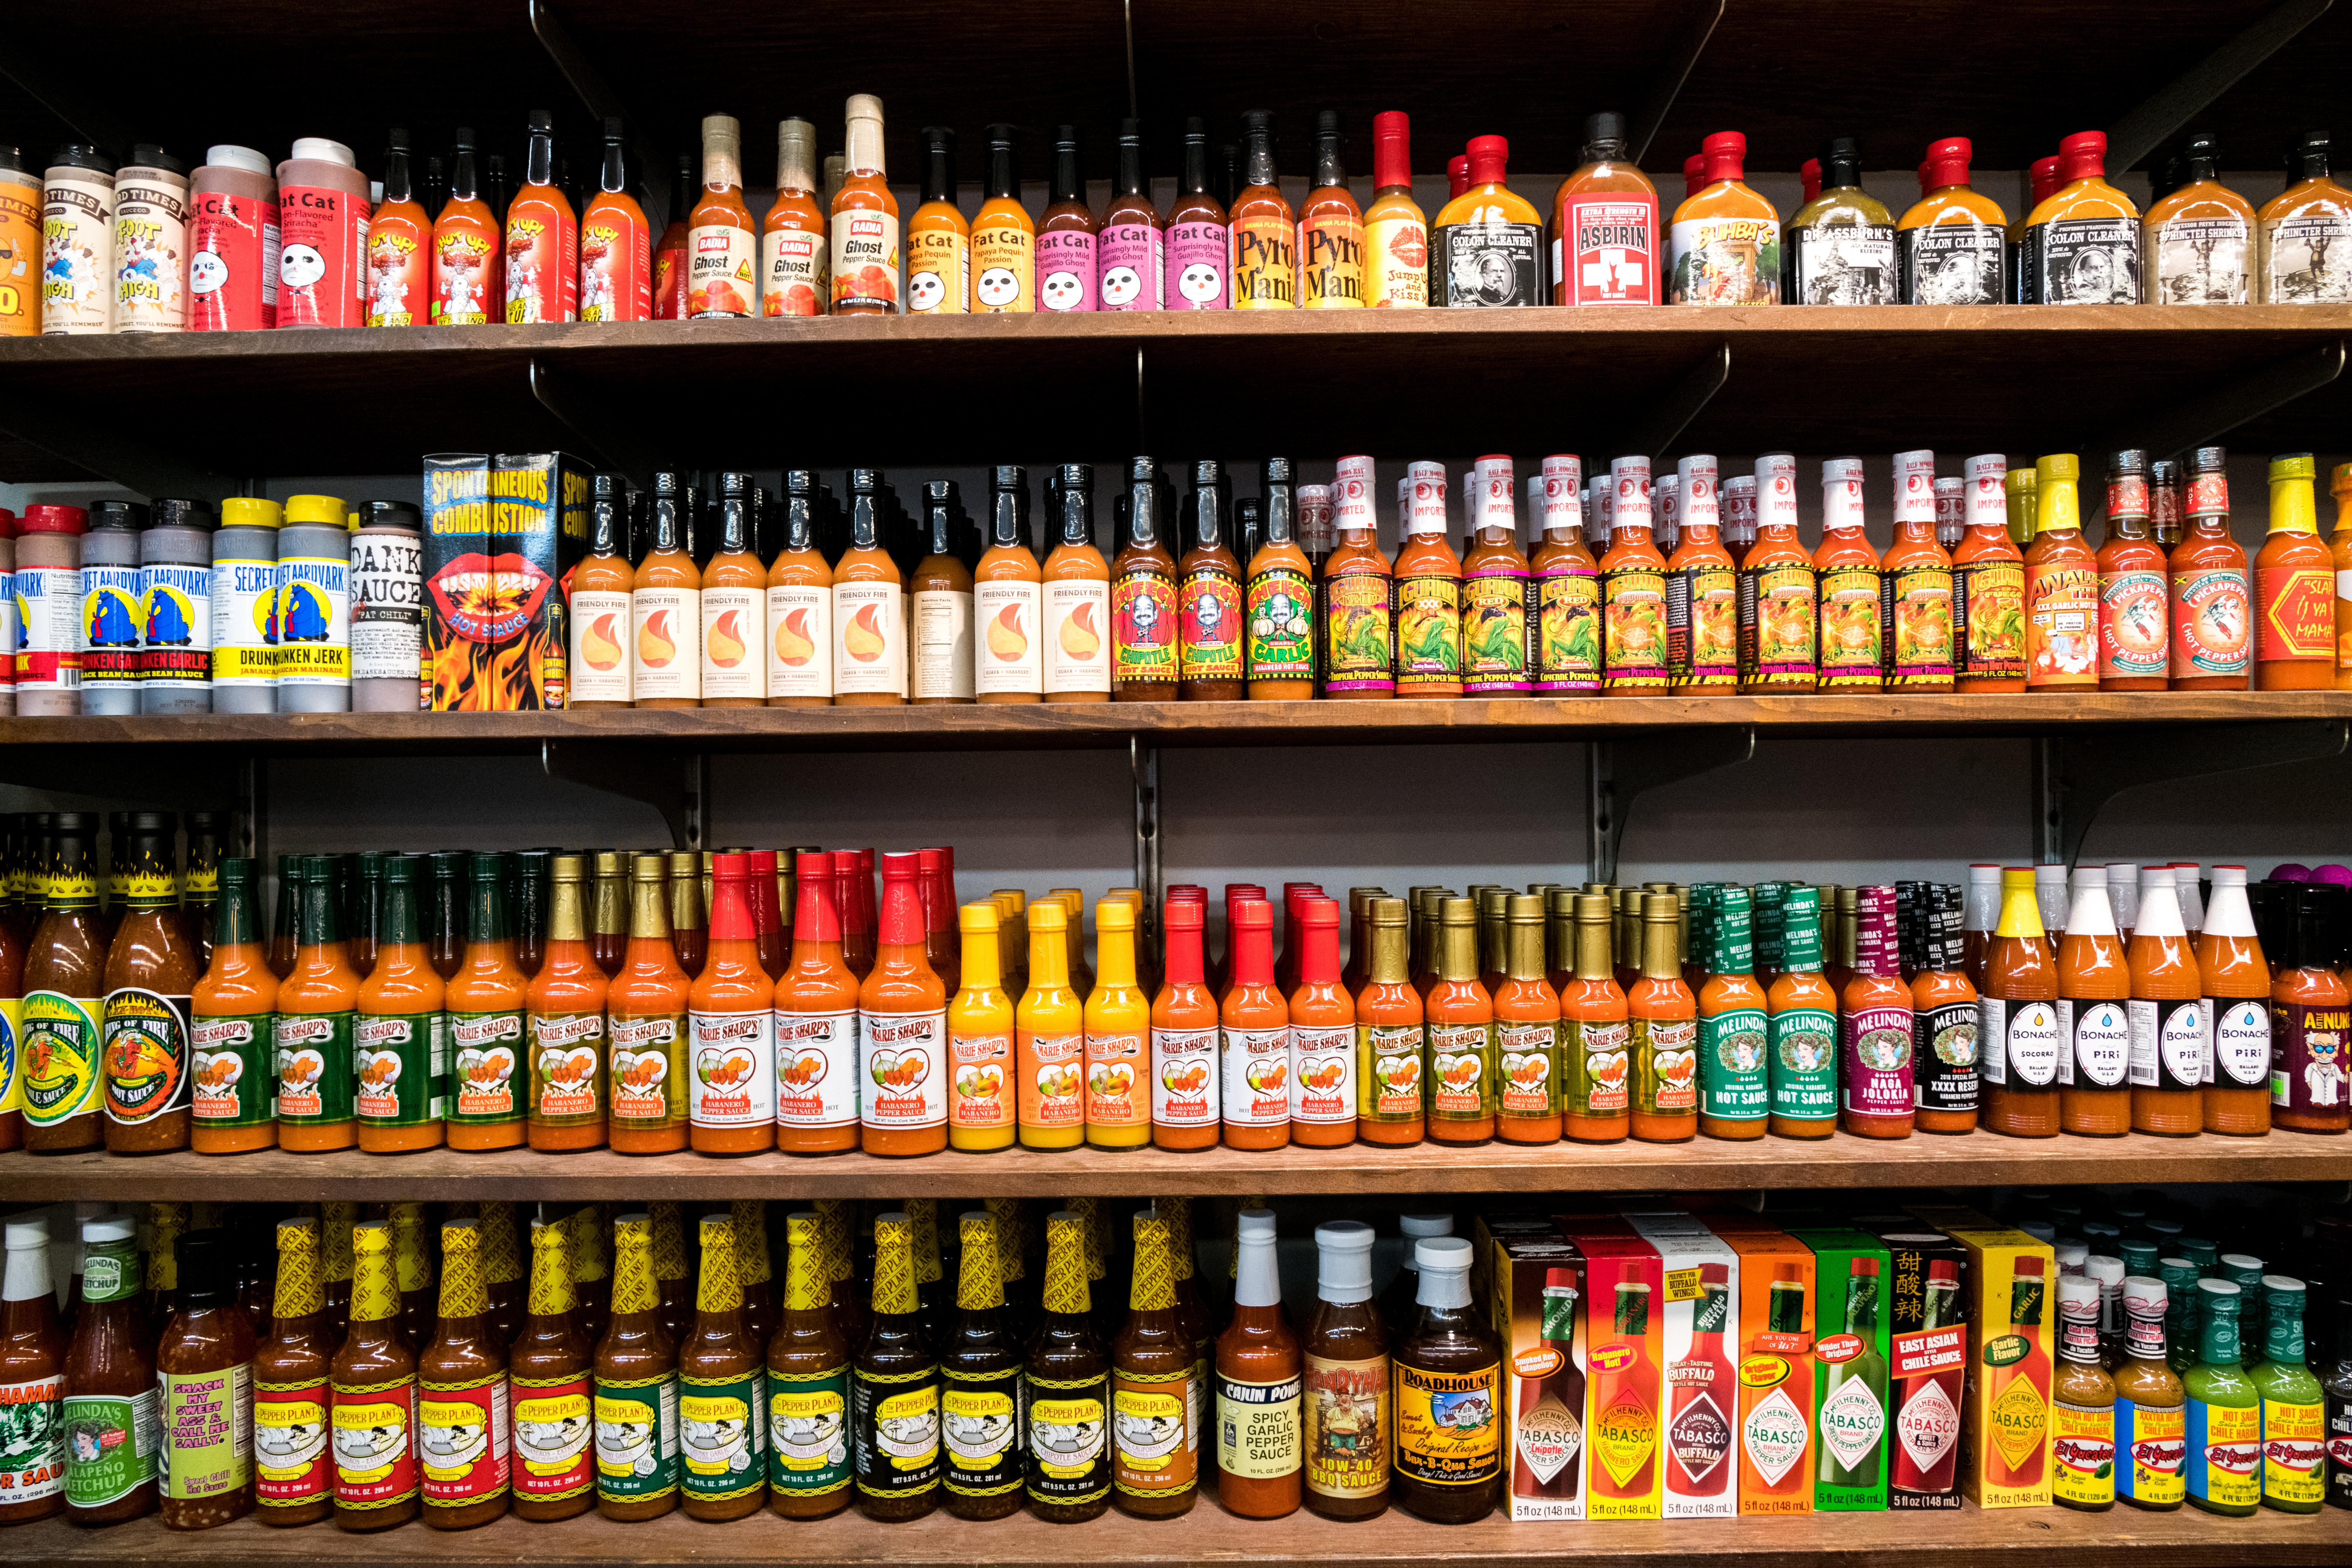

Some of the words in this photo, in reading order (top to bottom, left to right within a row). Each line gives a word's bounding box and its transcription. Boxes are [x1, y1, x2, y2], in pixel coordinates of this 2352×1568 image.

[134, 189, 179, 211] TIMES
[301, 193, 335, 210] Cat
[852, 221, 882, 234] BADIA
[1694, 221, 1774, 249] BUHBA'S
[2208, 228, 2246, 238] SHRINKE
[437, 231, 462, 256] SHUT
[469, 235, 492, 256] UP!
[974, 234, 994, 248] Fat
[999, 231, 1025, 246] Cat
[1453, 236, 1484, 247] COLON
[1487, 236, 1532, 247] CLEANER
[1580, 227, 1646, 251] ASBIRIN
[846, 240, 883, 254] Ghost
[974, 247, 996, 258] Papaya
[999, 249, 1024, 258] Pequin
[1173, 244, 1212, 253] Surprisingly
[1306, 229, 1362, 272] Pyro
[843, 255, 865, 264] Pepper
[866, 256, 885, 264] Sauce
[1177, 251, 1205, 261] Guajillo
[1206, 252, 1223, 261] Ghost
[119, 282, 159, 300] HIGH
[432, 469, 548, 506] SPONTANEOUS
[1546, 503, 1578, 514] IMPORTED
[432, 502, 546, 534] COMBUSTION
[352, 546, 422, 575] DANK
[235, 566, 273, 591] SECRET
[292, 564, 344, 592] AARDVARK
[352, 579, 422, 604] SAUCE
[1398, 580, 1458, 604] IGUANA
[2193, 583, 2247, 604] PICKAPEPPA
[1565, 596, 1587, 604] RED
[2314, 604, 2327, 617] YA
[449, 612, 479, 634] HOT
[2183, 629, 2199, 648] HOT
[2198, 646, 2240, 662] PEPPER
[169, 654, 208, 669] GARLIC
[315, 649, 343, 664] JERK
[1120, 649, 1170, 664] CHIPOTLE
[1786, 929, 1818, 940] MELINDA'S
[457, 1026, 480, 1041] MARIE
[482, 1018, 517, 1037] SHARP'S
[872, 1028, 896, 1042] MARIE
[898, 1020, 931, 1038] SHARP'S
[1779, 1016, 1833, 1037] MELINDA'S
[1857, 1013, 1911, 1035] MELINDA'S
[142, 1021, 169, 1045] FIRE
[2222, 1029, 2268, 1039] BONACHE
[1870, 1078, 1902, 1088] NAGA
[1777, 1090, 1797, 1104] HOT
[1802, 1091, 1833, 1103] SAUCE
[1862, 1089, 1908, 1100] JOLOKIA
[1894, 1252, 1923, 1323] 甜酸辣
[1899, 1338, 1924, 1354] EAST
[1927, 1333, 1958, 1349] ASIAN
[1992, 1338, 2019, 1351] Garlic
[1515, 1356, 1541, 1365] Smoked
[1592, 1348, 1630, 1361] Habanero
[1902, 1357, 1928, 1370] CHILE
[1931, 1353, 1962, 1366] SAUCE
[1993, 1348, 2020, 1361] Flavor
[1520, 1361, 1554, 1373] Jalapeños
[1604, 1358, 1621, 1368] Hot!
[1745, 1361, 1778, 1374] Original
[1405, 1371, 1492, 1391] ROADHOUSE
[1668, 1368, 1715, 1382] BUFFALO
[1750, 1372, 1775, 1382] Flavor
[174, 1379, 224, 1393] SMACK
[1226, 1384, 1266, 1402] CAJUN
[187, 1393, 209, 1404] MY
[176, 1402, 223, 1415] SWEET
[340, 1410, 367, 1423] PEPPER
[369, 1408, 396, 1422] PLANT
[2280, 1406, 2295, 1418] HOT
[2299, 1408, 2319, 1419] SAUCE
[178, 1417, 206, 1426] ASS
[210, 1414, 221, 1423] &
[1253, 1410, 1289, 1424] SPICY
[1825, 1412, 1880, 1429] TABASCO
[171, 1425, 206, 1438] CALL
[209, 1421, 229, 1432] ME
[1247, 1421, 1293, 1435] GARLIC
[1247, 1432, 1293, 1447] PEPPER
[1519, 1429, 1579, 1443] TABASCO
[786, 1444, 806, 1453] CHUNKY
[808, 1441, 828, 1452] GARLIC
[1040, 1448, 1072, 1461] CHIPOTLE
[1073, 1446, 1093, 1459] SAUCE
[1250, 1446, 1291, 1459] SAUCE
[1416, 1438, 1451, 1453] Original
[1454, 1443, 1480, 1454] Recipe
[637, 1457, 656, 1469] GARLIC
[1321, 1458, 1372, 1472] 10W-40
[184, 1475, 208, 1486] Sweet
[211, 1470, 230, 1482] Chili
[1312, 1468, 1336, 1485] BBQ
[1342, 1471, 1381, 1487] SAUCE
[187, 1484, 201, 1494] Hot
[203, 1481, 228, 1492] Sauce
